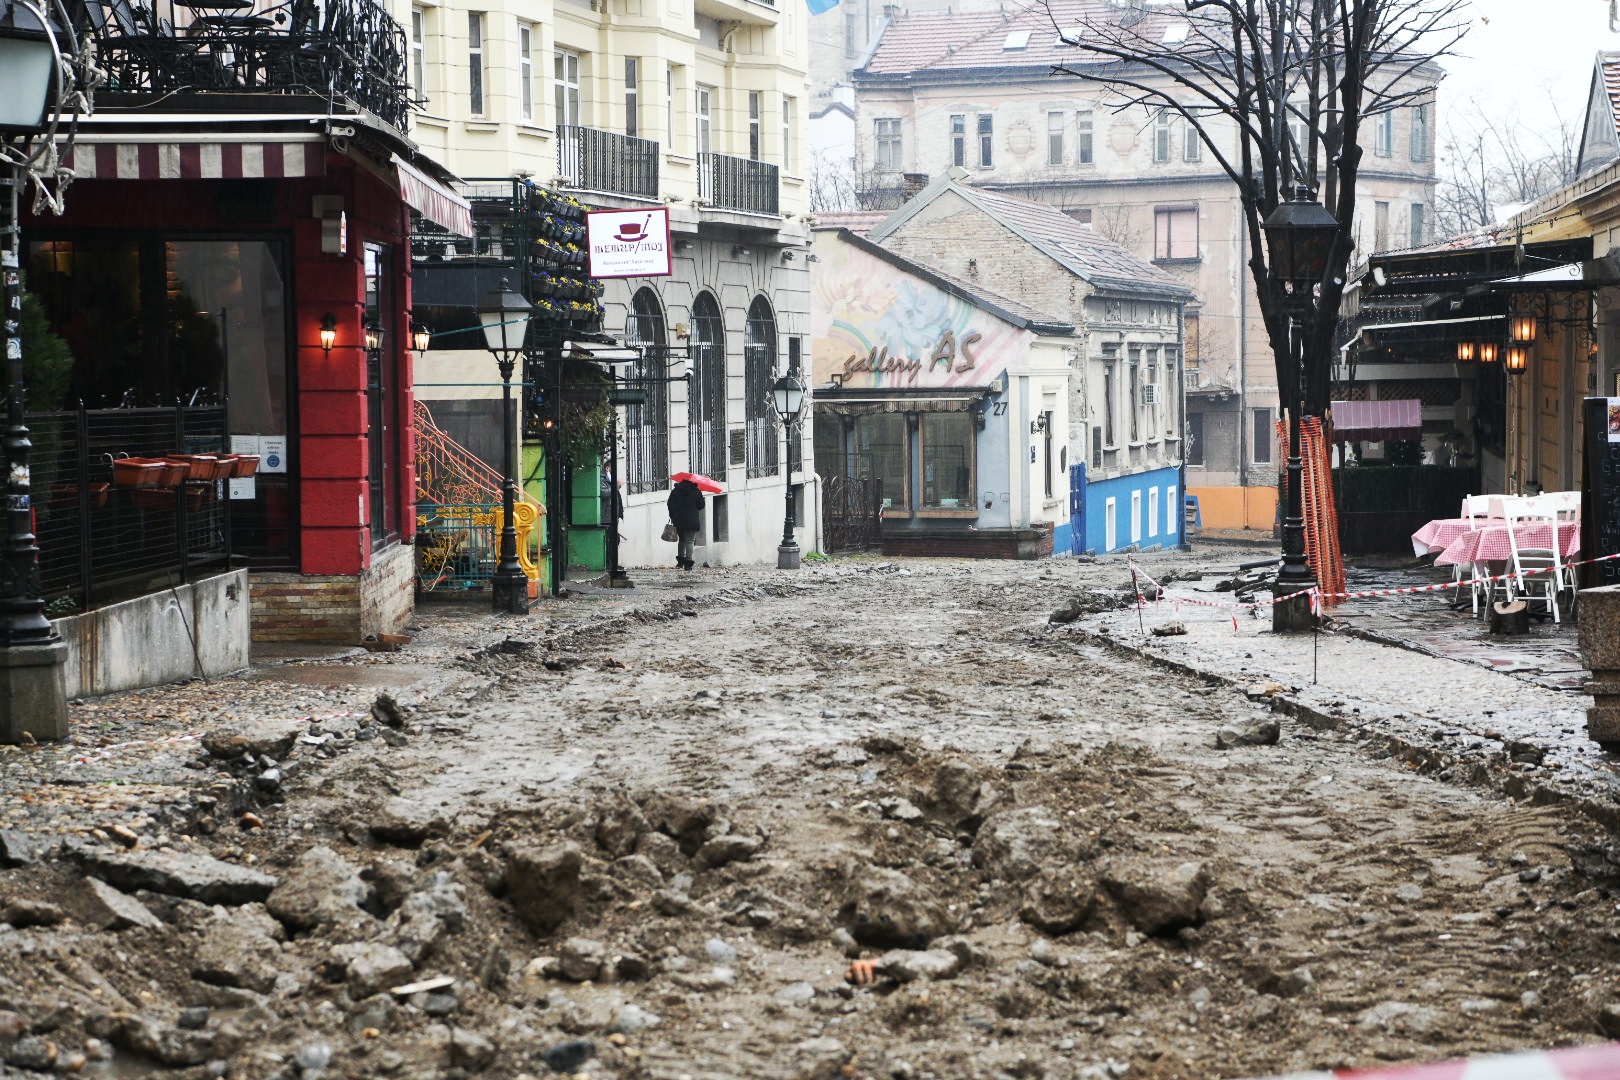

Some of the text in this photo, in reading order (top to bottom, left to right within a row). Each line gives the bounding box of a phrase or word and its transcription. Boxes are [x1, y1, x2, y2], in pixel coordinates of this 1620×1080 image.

[842, 330, 982, 383] gallery AS
[993, 402, 1008, 416] 27
